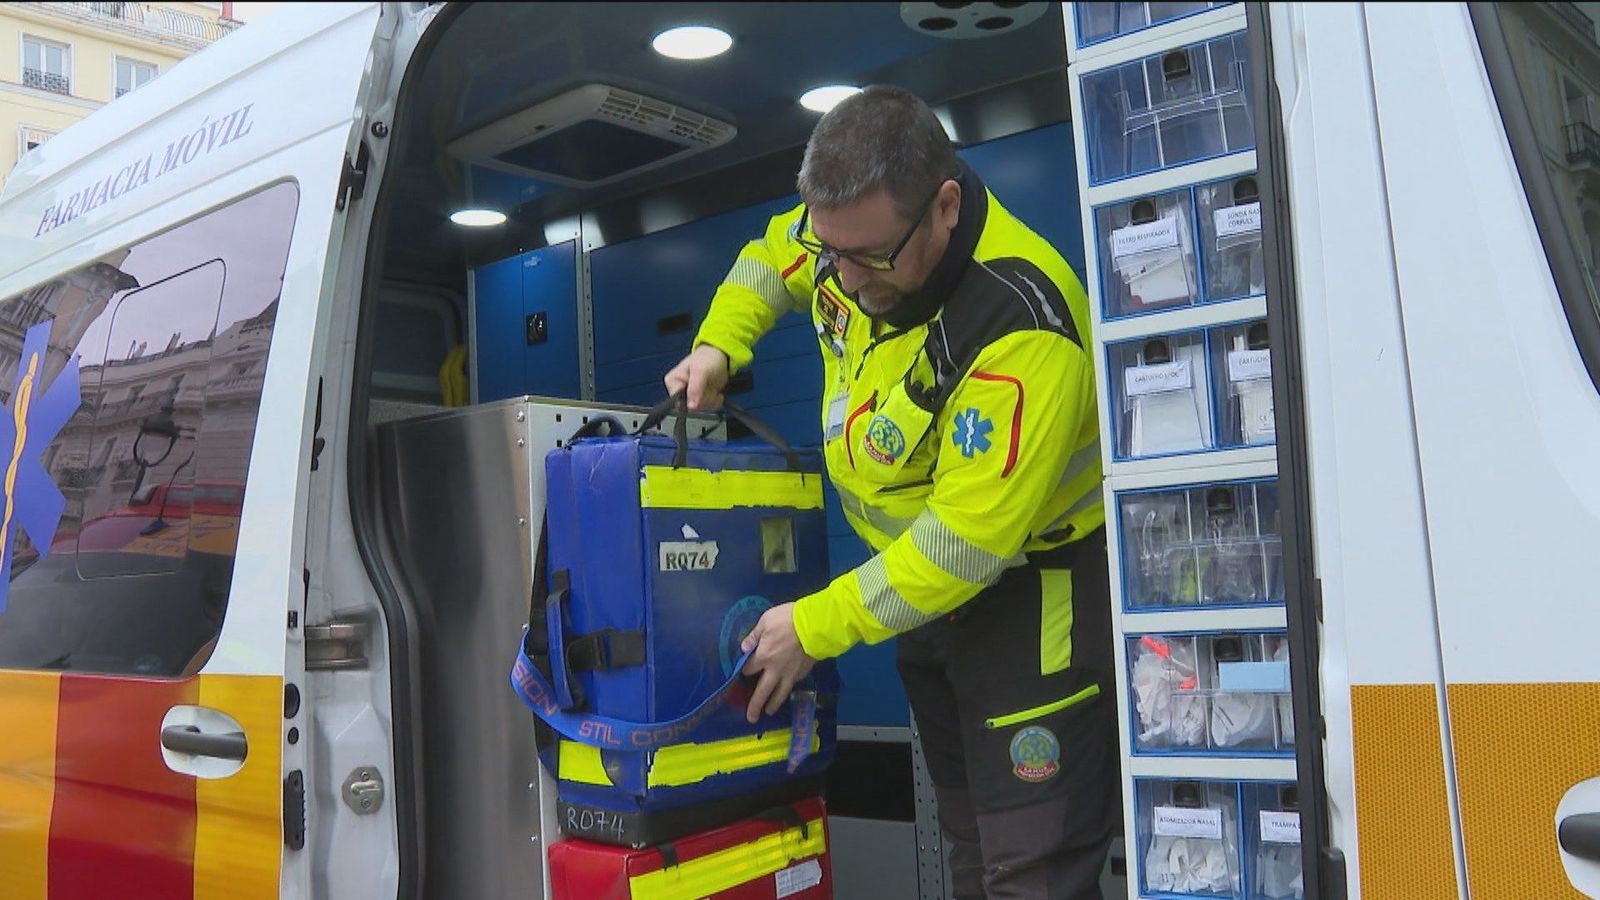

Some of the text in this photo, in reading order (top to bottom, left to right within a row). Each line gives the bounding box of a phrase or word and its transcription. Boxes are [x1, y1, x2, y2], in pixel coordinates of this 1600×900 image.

[34, 103, 254, 238] FARMACIA MÓVIL
[579, 720, 622, 745] STIL
[1159, 816, 1216, 827] ATOMIZADOR NASAL
[1271, 821, 1297, 830] TRAMPA
